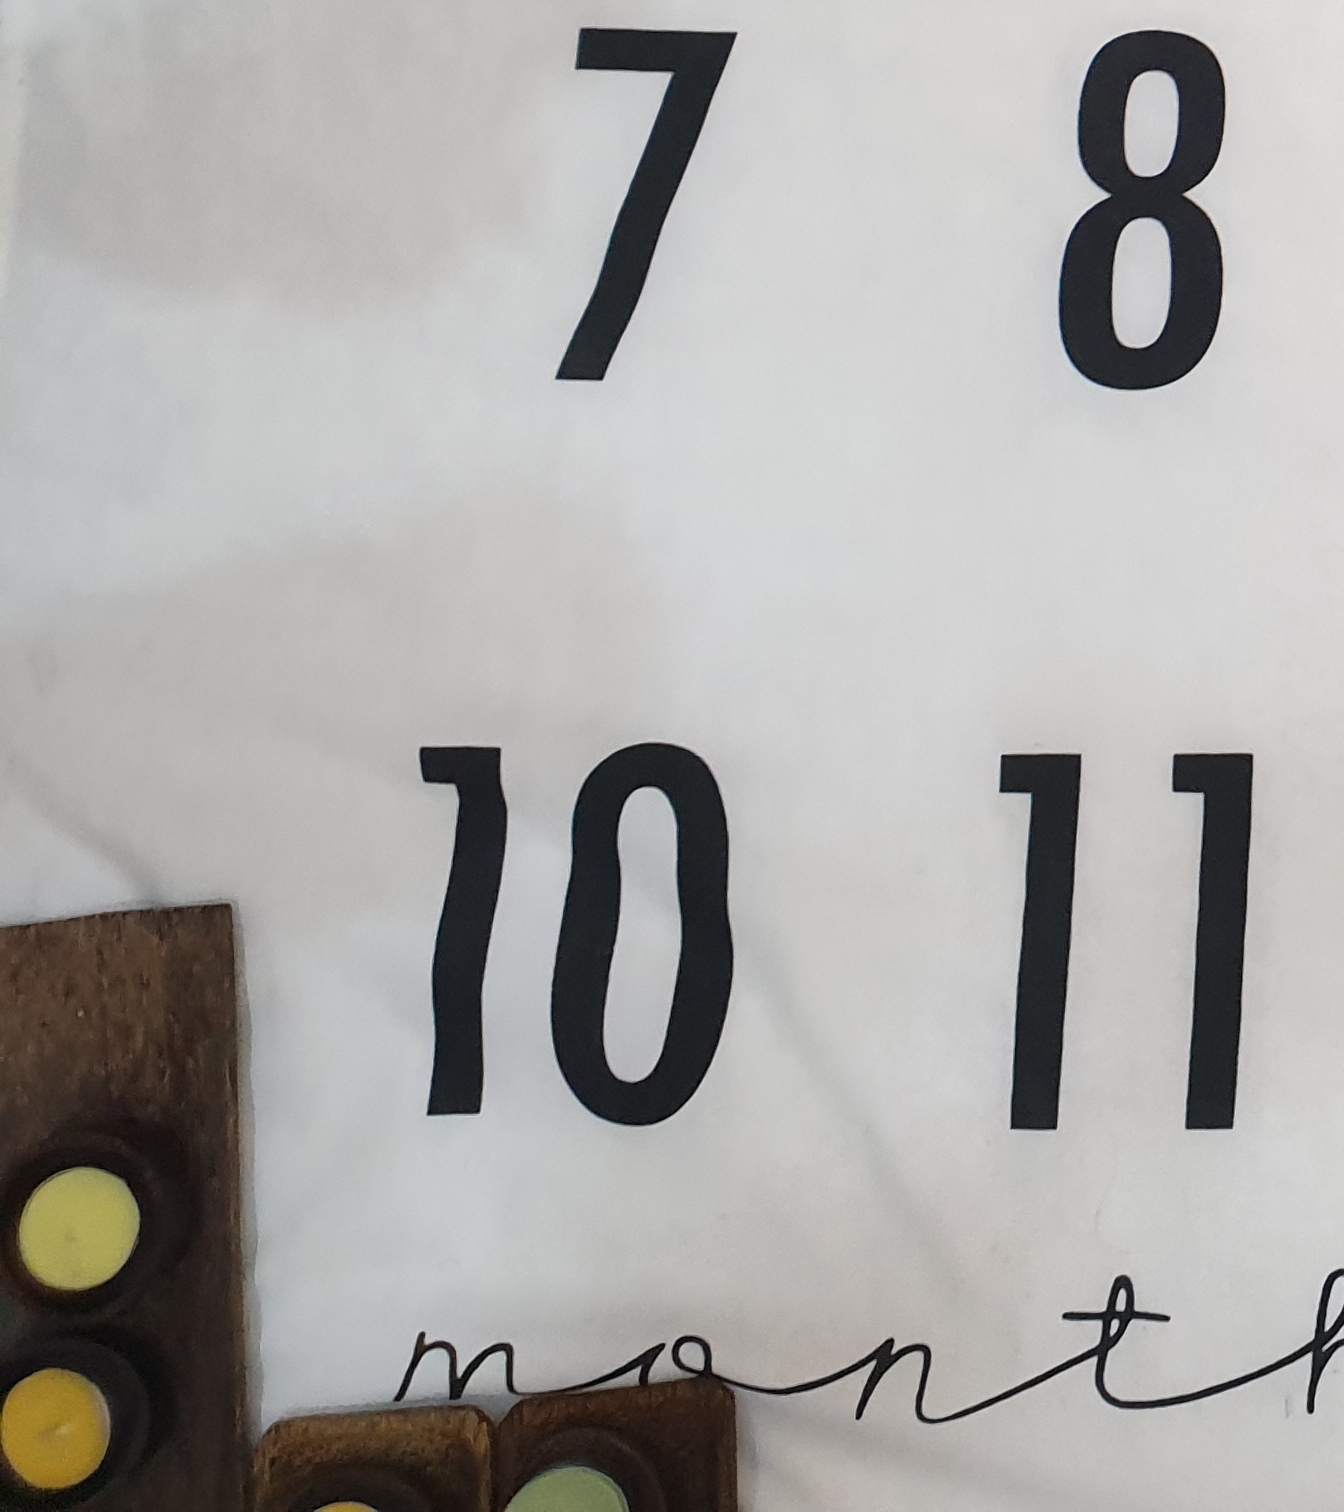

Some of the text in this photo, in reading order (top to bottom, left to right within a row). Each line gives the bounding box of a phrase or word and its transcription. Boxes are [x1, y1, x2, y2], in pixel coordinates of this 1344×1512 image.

[556, 28, 737, 380] 7
[1059, 31, 1225, 390] 8
[420, 743, 733, 1126] 10
[1000, 754, 1253, 1130] 11
